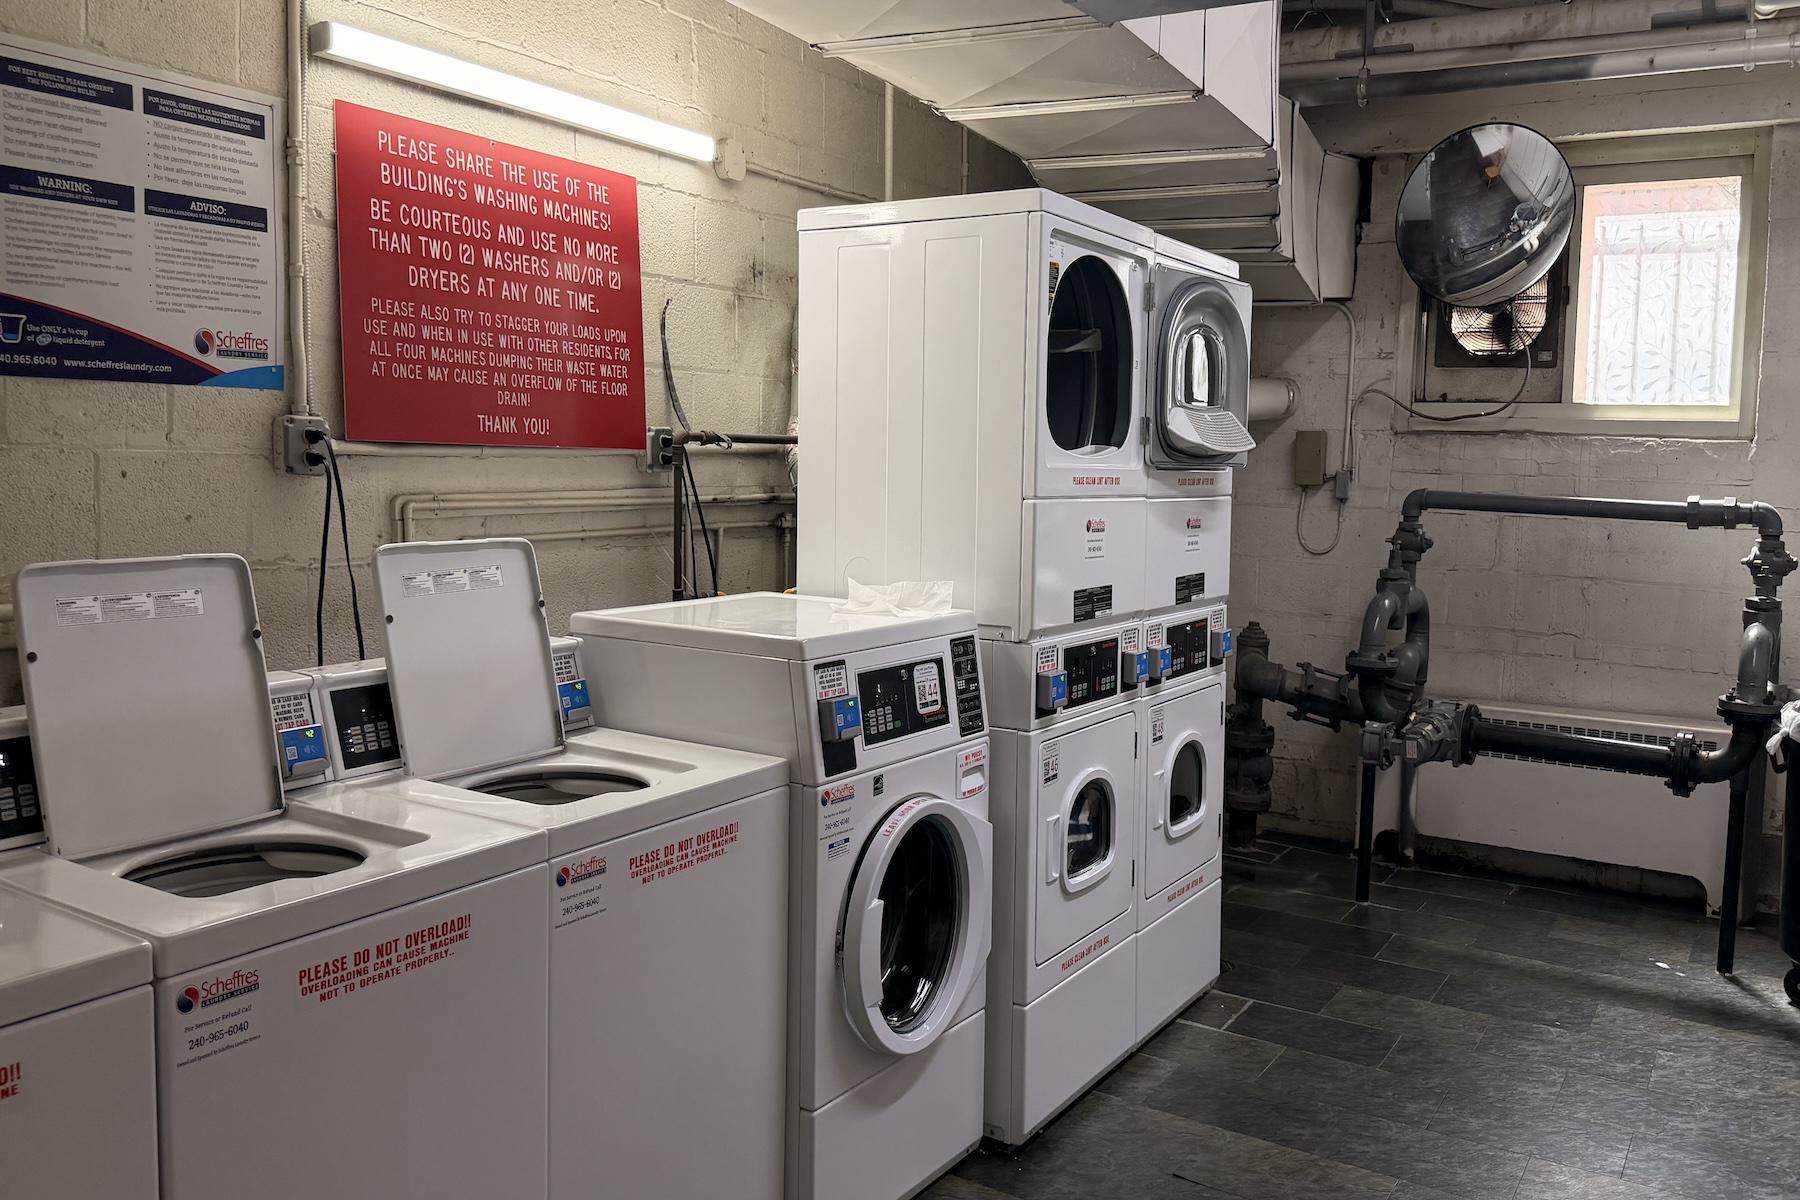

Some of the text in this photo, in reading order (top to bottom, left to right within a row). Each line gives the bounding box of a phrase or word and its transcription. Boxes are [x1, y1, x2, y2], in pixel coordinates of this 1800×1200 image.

[38, 176, 92, 194] WARNING:
[378, 130, 609, 205] PLEASE SHARE THE USE OF THE
[190, 201, 226, 215] ADVISO:
[381, 162, 612, 231] BUILDING'S WASHING MACHINES!
[370, 198, 619, 264] BE COURTEOUS AND USE NO MORE
[369, 228, 621, 289] THAN TWO (2) WASHERS AND/OR (2)
[409, 266, 600, 313] DRYERS AT ANY ONE TIME.
[372, 298, 626, 343] PLEASE ALSO TRY TO STAGGER YOUR LOADS UPON
[74, 338, 105, 347] detergent
[217, 330, 268, 350] Scheffres
[364, 318, 387, 336] USE
[393, 322, 416, 339] AND
[422, 325, 452, 343] WHEN
[458, 329, 468, 344] IN
[473, 330, 493, 347] USE
[499, 333, 523, 350] WITH
[528, 336, 558, 354] OTHER
[614, 346, 630, 362] FOR
[64, 359, 172, 373] www.scheffreslaundry.com
[370, 340, 628, 379] ALL FOUR MACHINES DUMPING THEIR WASTE WATER
[372, 361, 628, 396] AT ONCE MAY CAUSE AN OVERFLOW OF THE FLOOR
[498, 391, 530, 407] DRAIN!
[478, 414, 550, 435] THANK YOU!
[928, 683, 938, 697] 44
[630, 822, 738, 870] PLEASE DO NOT OVERLOAD!!
[631, 835, 736, 878] OVERLOADING CAN CAUSE MACHINE
[571, 856, 607, 876] Scheffres
[643, 874, 654, 884] NOT
[658, 870, 665, 879] TO
[668, 860, 694, 875] OPERATE
[299, 914, 471, 986] PLEASE DO NOT OVERLOAD!!
[301, 931, 469, 996] OVERLOADING CAN CAUSE MACHINE
[202, 969, 259, 998] Scheffres
[320, 987, 339, 1002] NOT
[343, 982, 355, 994] TO
[360, 966, 401, 988] OPERATE
[185, 1024, 194, 1033] For
[195, 1017, 214, 1029] Service
[222, 1008, 240, 1020] Refund
[242, 1004, 252, 1014] Call
[188, 1021, 248, 1050] 240-965-6040
